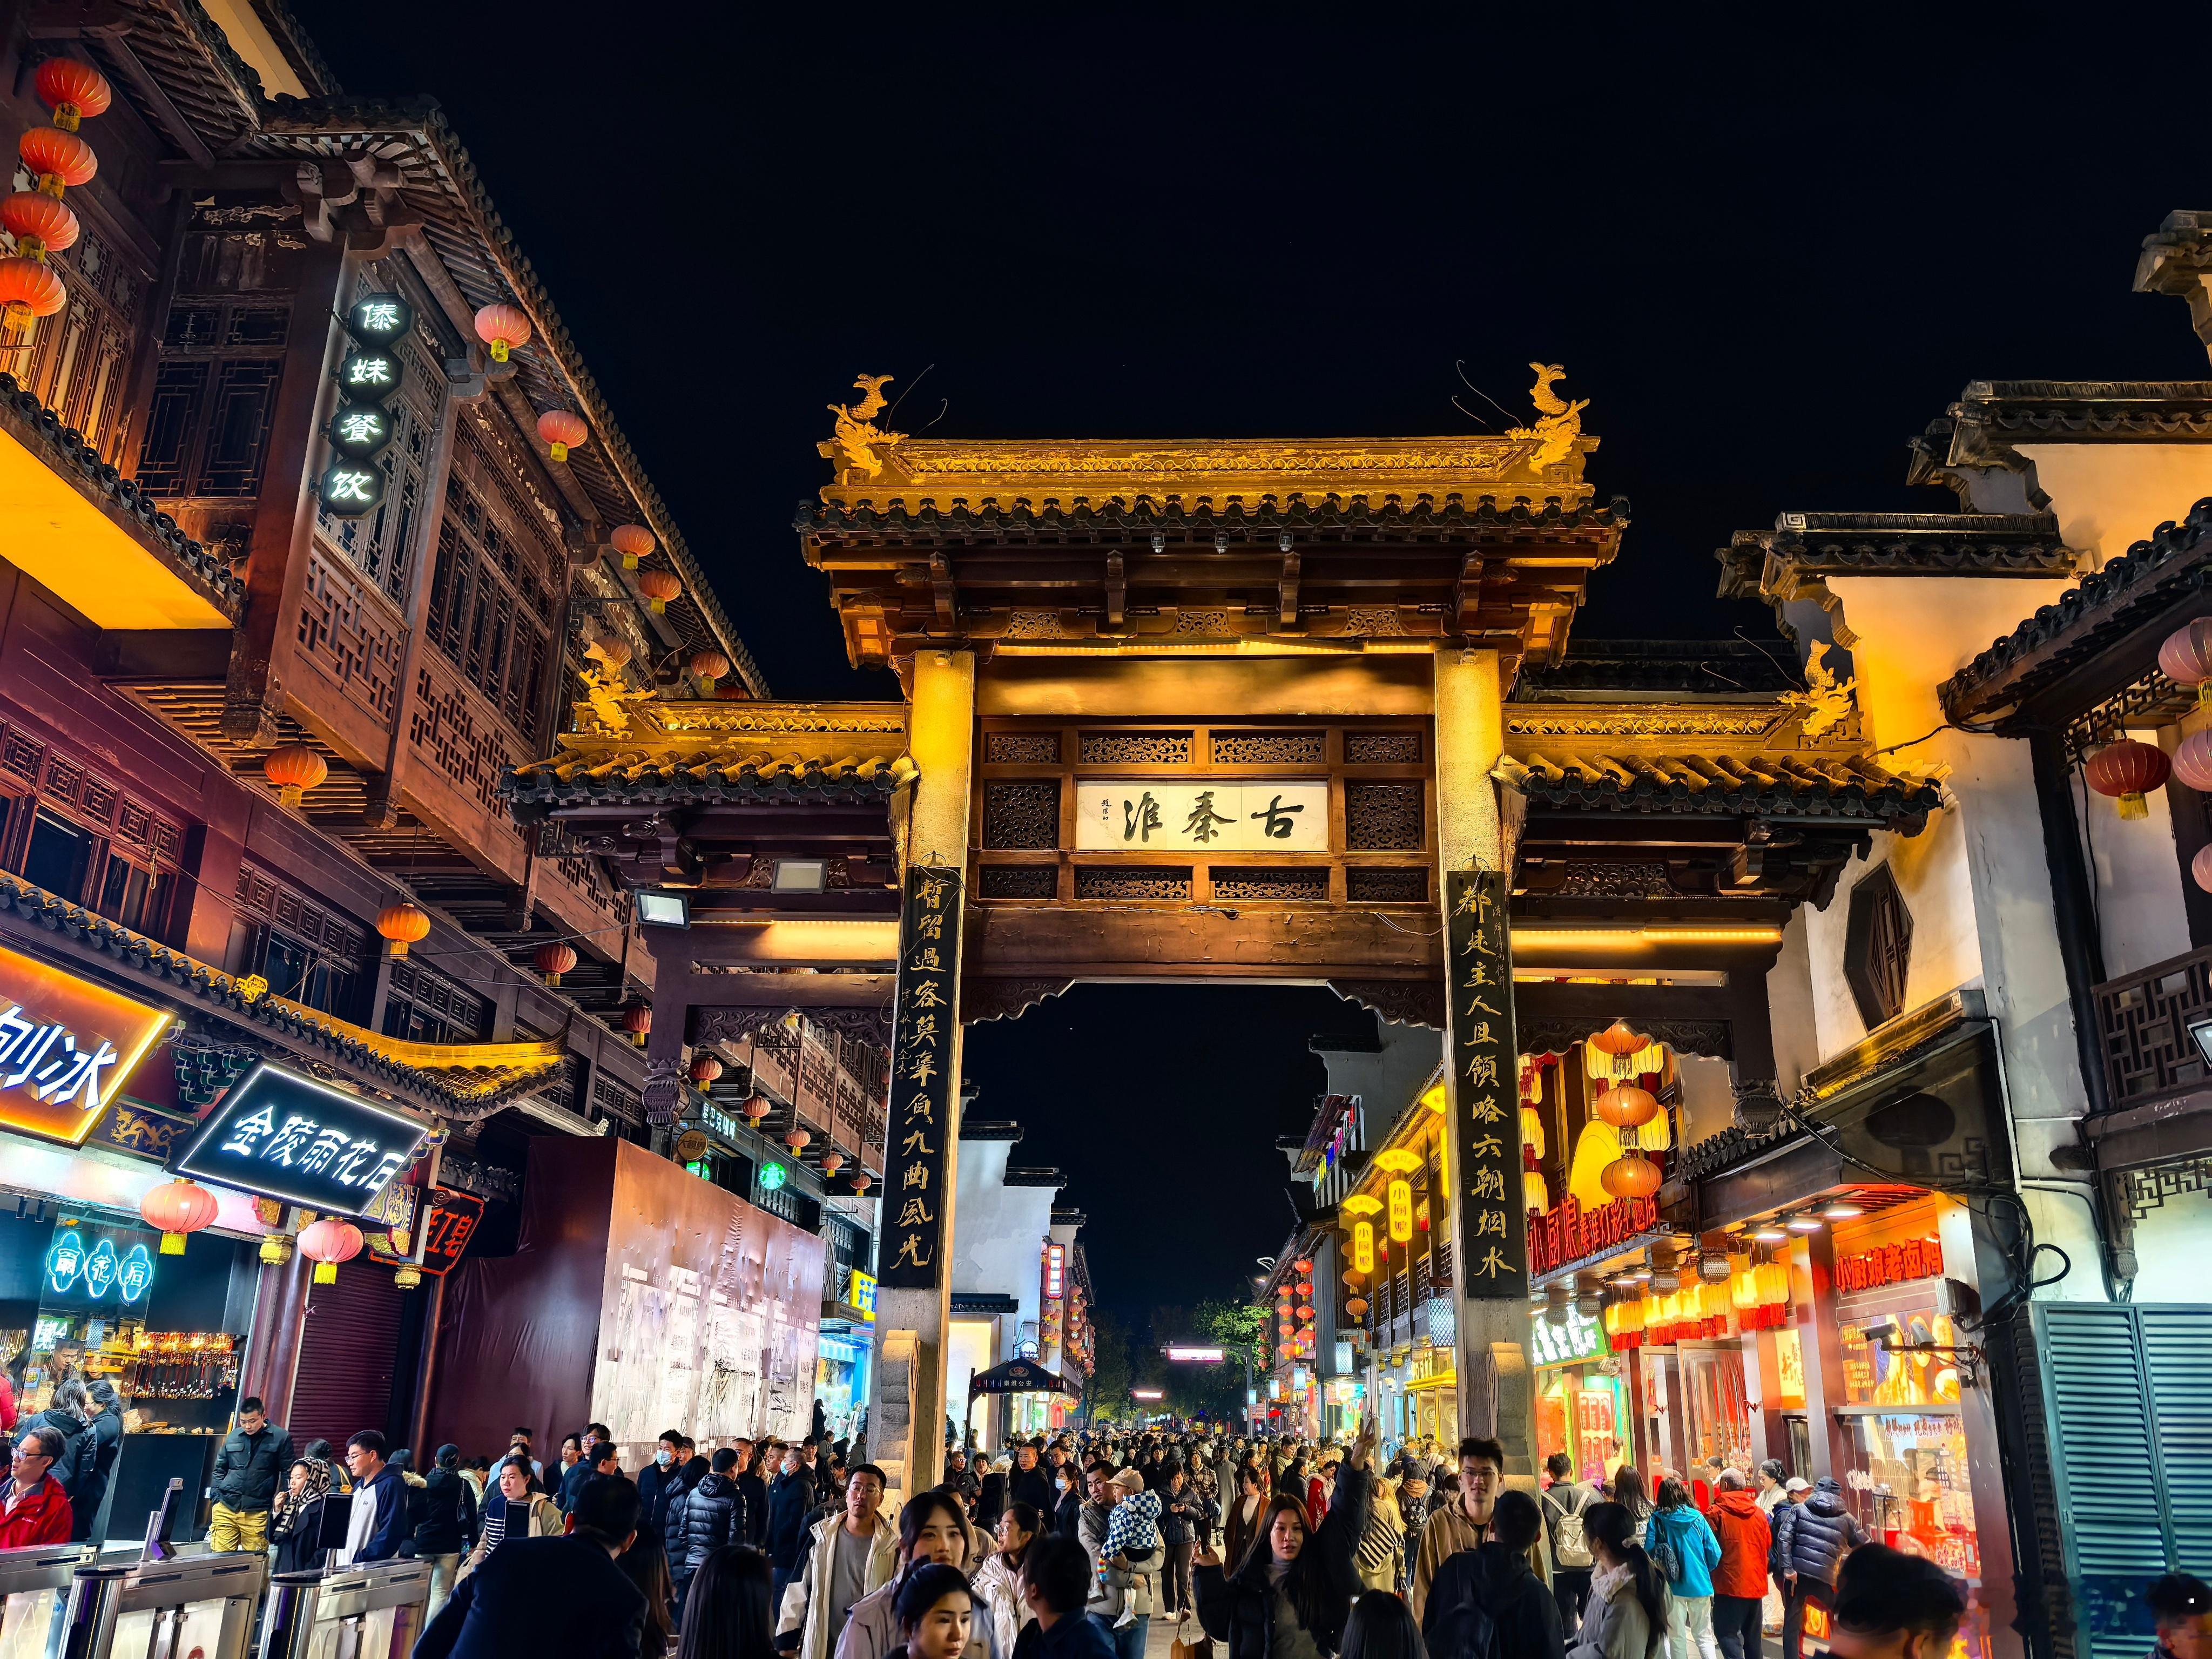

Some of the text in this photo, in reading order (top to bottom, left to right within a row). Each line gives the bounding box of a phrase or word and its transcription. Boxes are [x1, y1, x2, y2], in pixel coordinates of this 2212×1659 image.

[331, 303, 400, 501] 傣妹餐饮
[1393, 1188, 1407, 1232] 小厨娘
[1358, 1228, 1370, 1266] 小厨娘
[1834, 1231, 1944, 1294] 小厨娘老卤鸭
